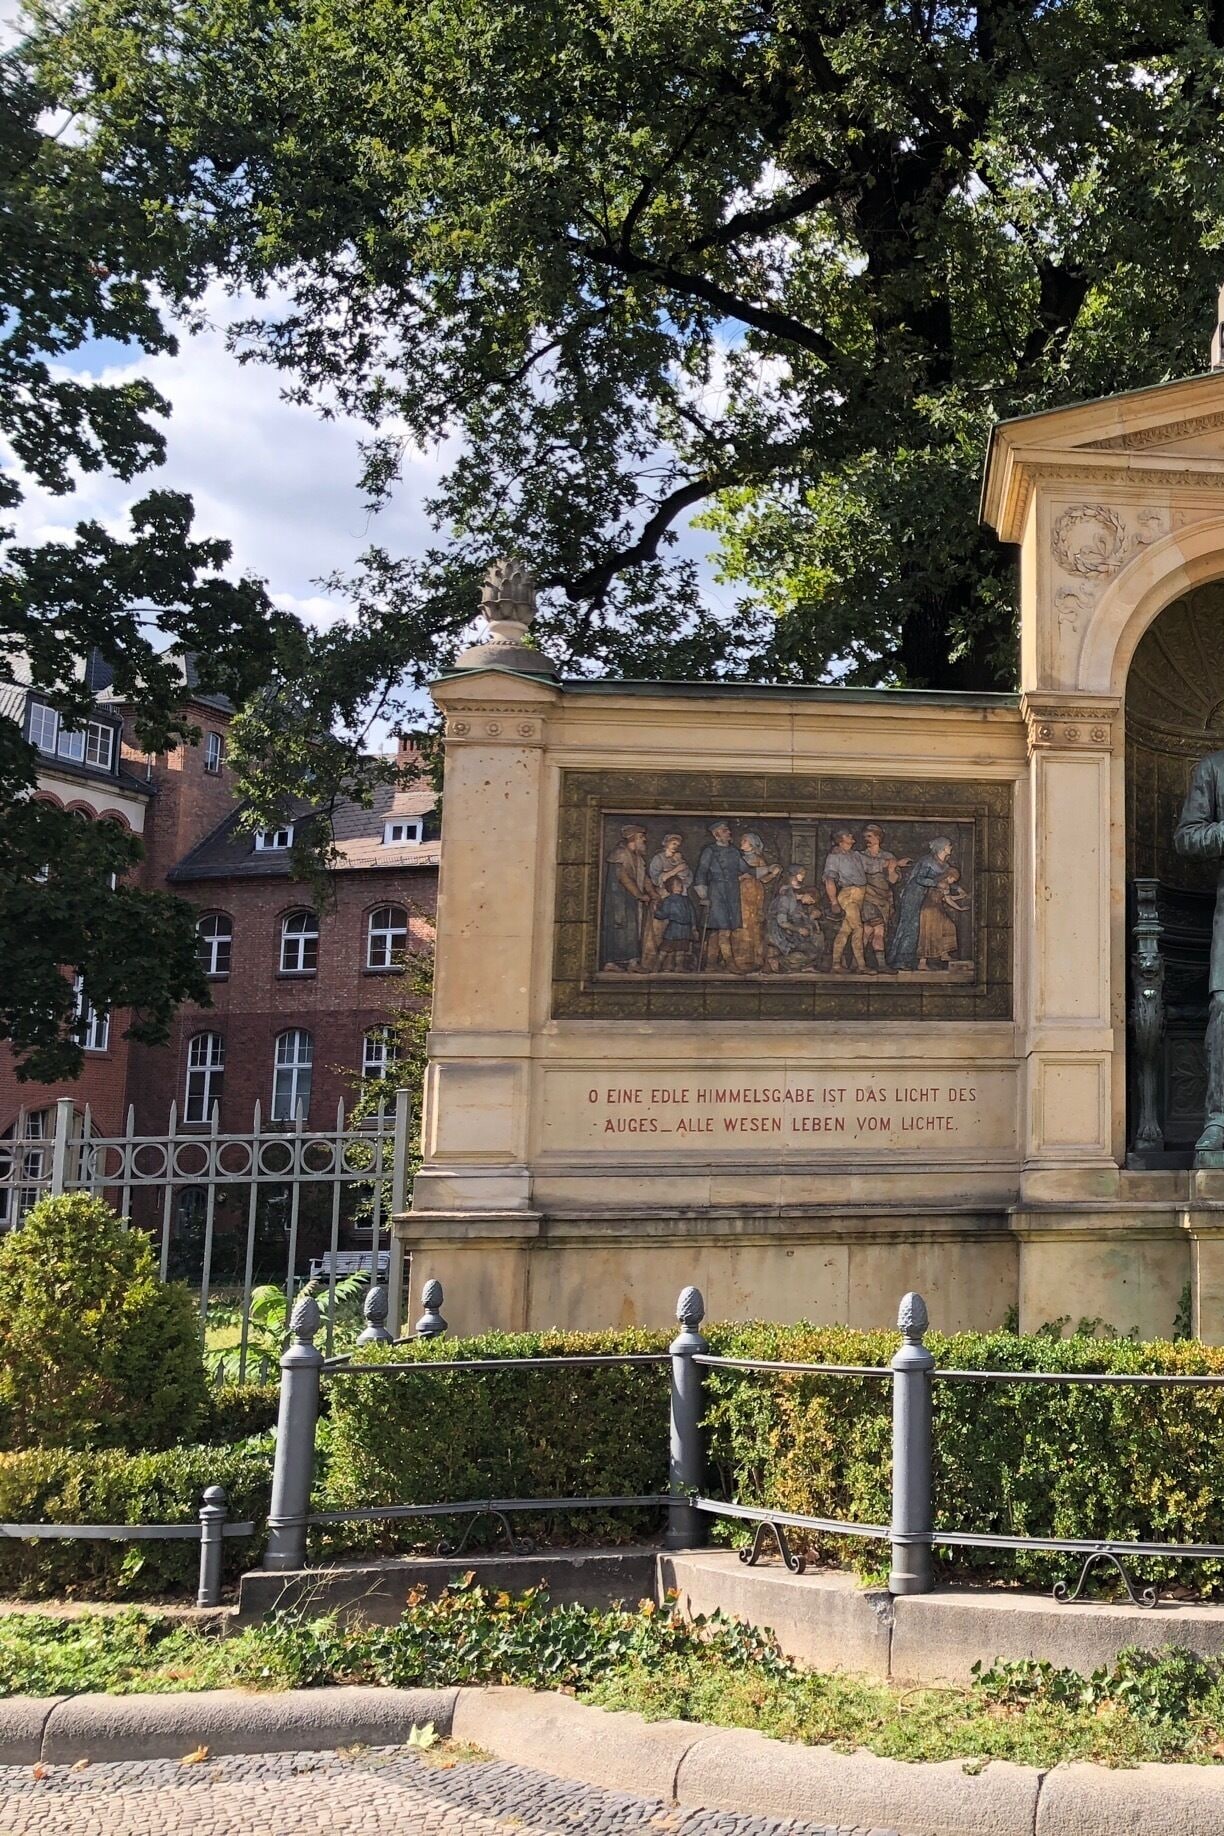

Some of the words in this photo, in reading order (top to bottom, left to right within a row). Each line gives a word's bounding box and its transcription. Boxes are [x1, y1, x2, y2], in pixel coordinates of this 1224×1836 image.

[588, 1089, 599, 1104] O
[606, 1089, 644, 1104] EINE
[651, 1089, 690, 1104] EDLE
[697, 1088, 815, 1104] HIMMELSGABE
[823, 1088, 847, 1104] IST
[856, 1088, 887, 1103] DAS
[895, 1087, 940, 1103] LICHT
[948, 1087, 977, 1103] DES
[604, 1118, 659, 1133] AUGES
[676, 1118, 714, 1133] ALLE
[723, 1117, 782, 1133] WESEN
[792, 1117, 846, 1132] LEBEN
[857, 1117, 892, 1132] VOM
[901, 1116, 959, 1132] LICHTE.
